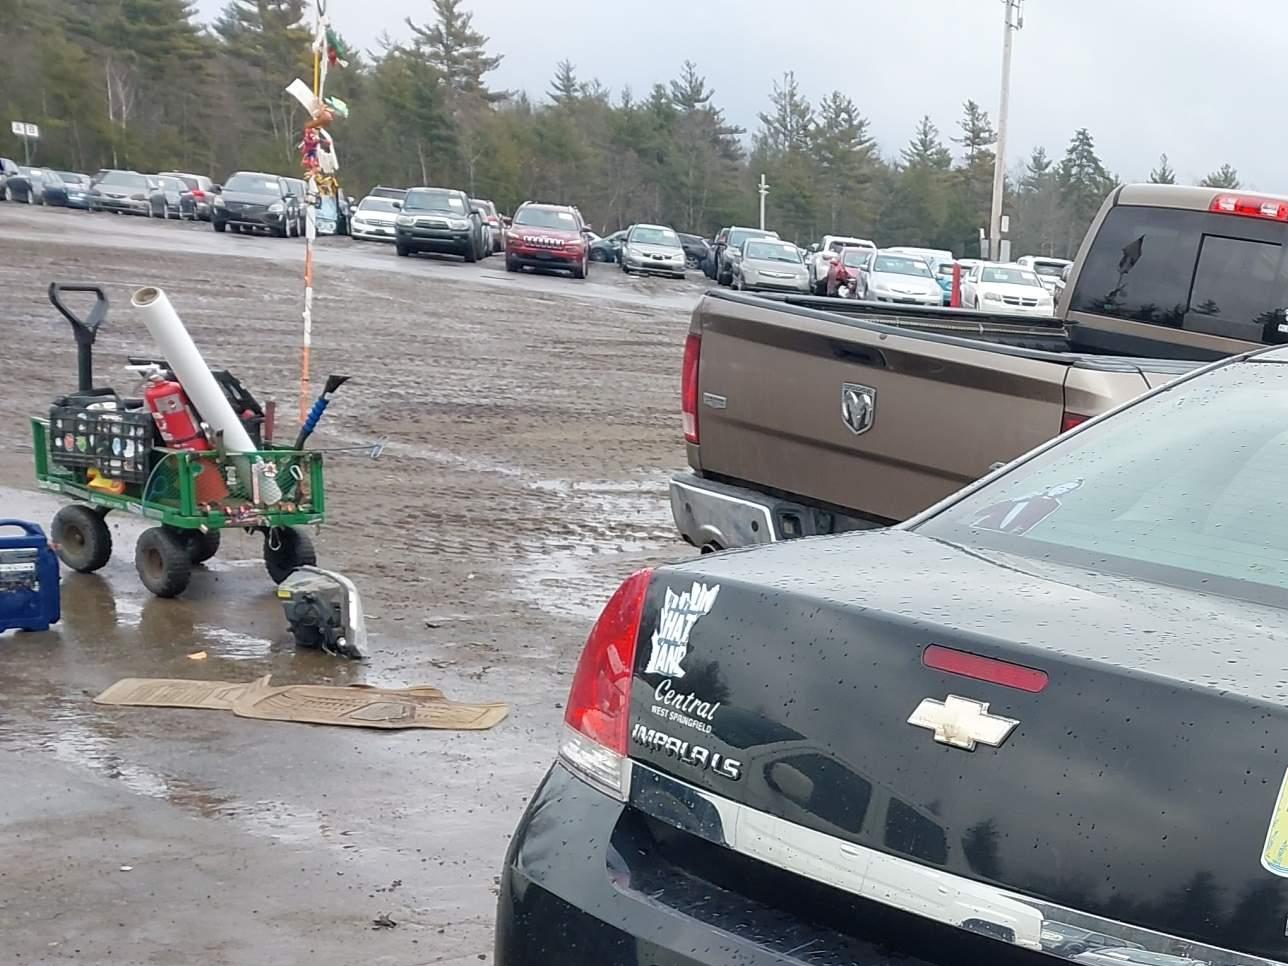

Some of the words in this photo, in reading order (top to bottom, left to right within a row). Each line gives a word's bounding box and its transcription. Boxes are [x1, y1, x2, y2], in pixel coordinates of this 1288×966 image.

[651, 705, 669, 718] WEST
[668, 711, 712, 734] SPRINGFIELD
[654, 679, 720, 720] Central
[632, 723, 709, 765] IMPALA
[711, 753, 742, 780] LS
